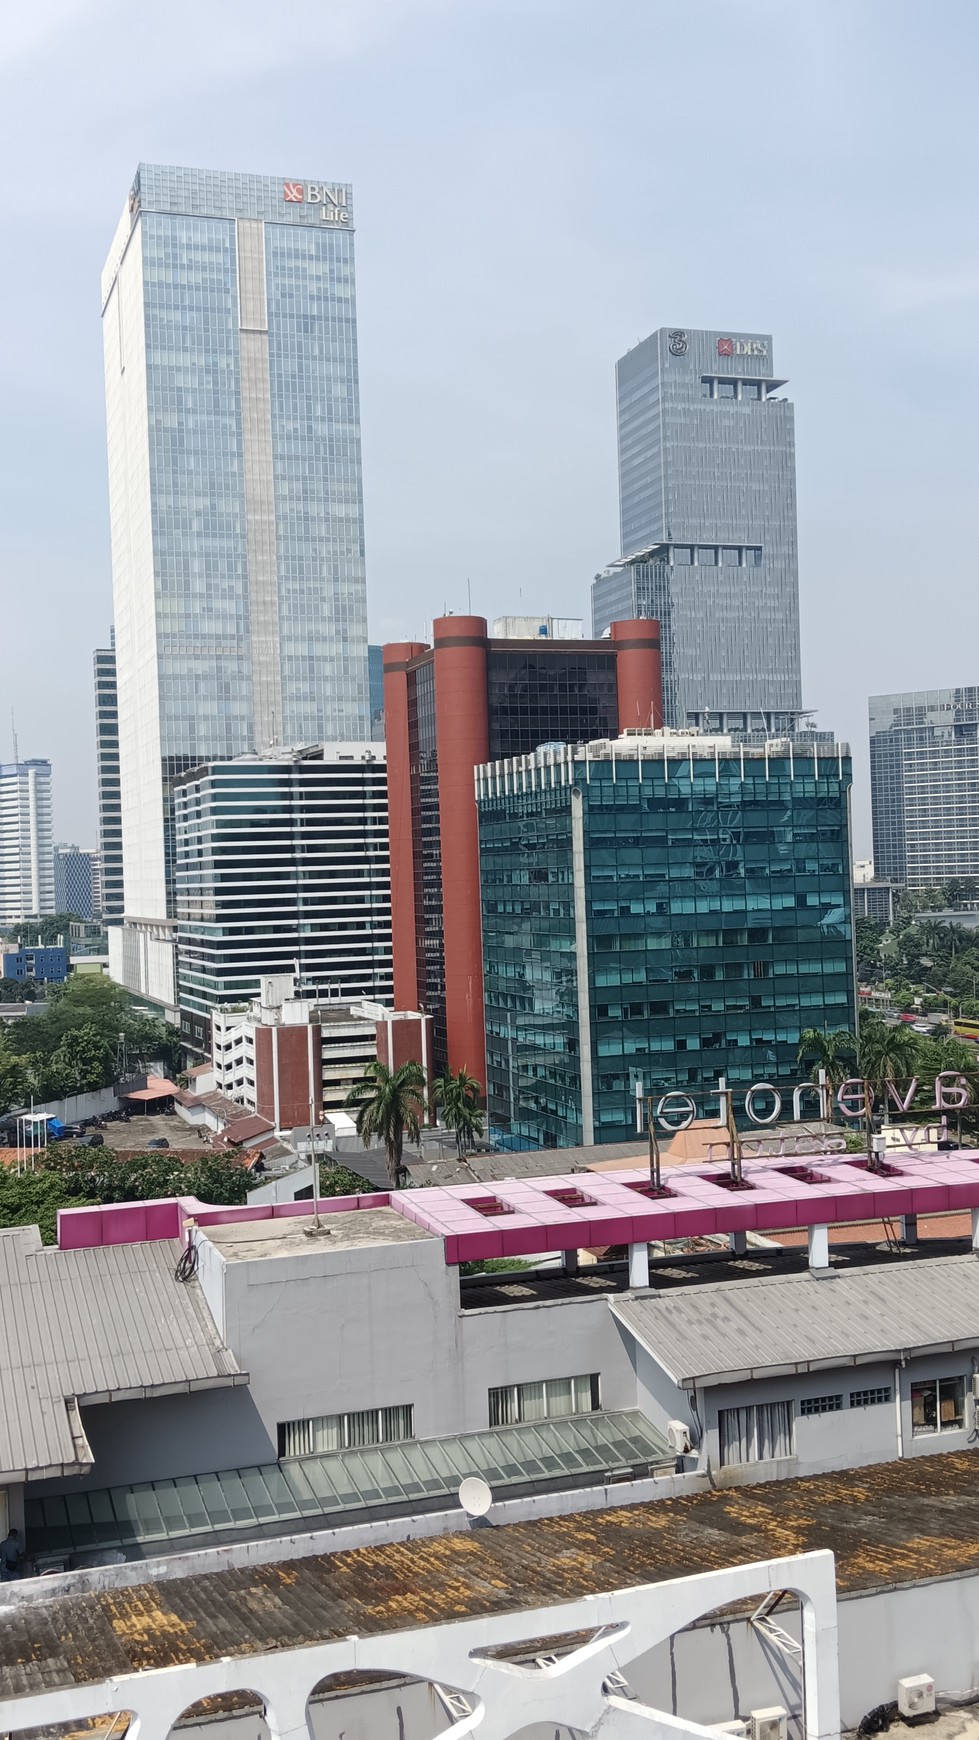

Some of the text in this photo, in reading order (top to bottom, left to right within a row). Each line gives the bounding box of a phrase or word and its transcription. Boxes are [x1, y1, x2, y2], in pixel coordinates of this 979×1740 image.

[307, 184, 347, 207] BNI
[322, 206, 349, 223] Life
[736, 341, 768, 356] DBS
